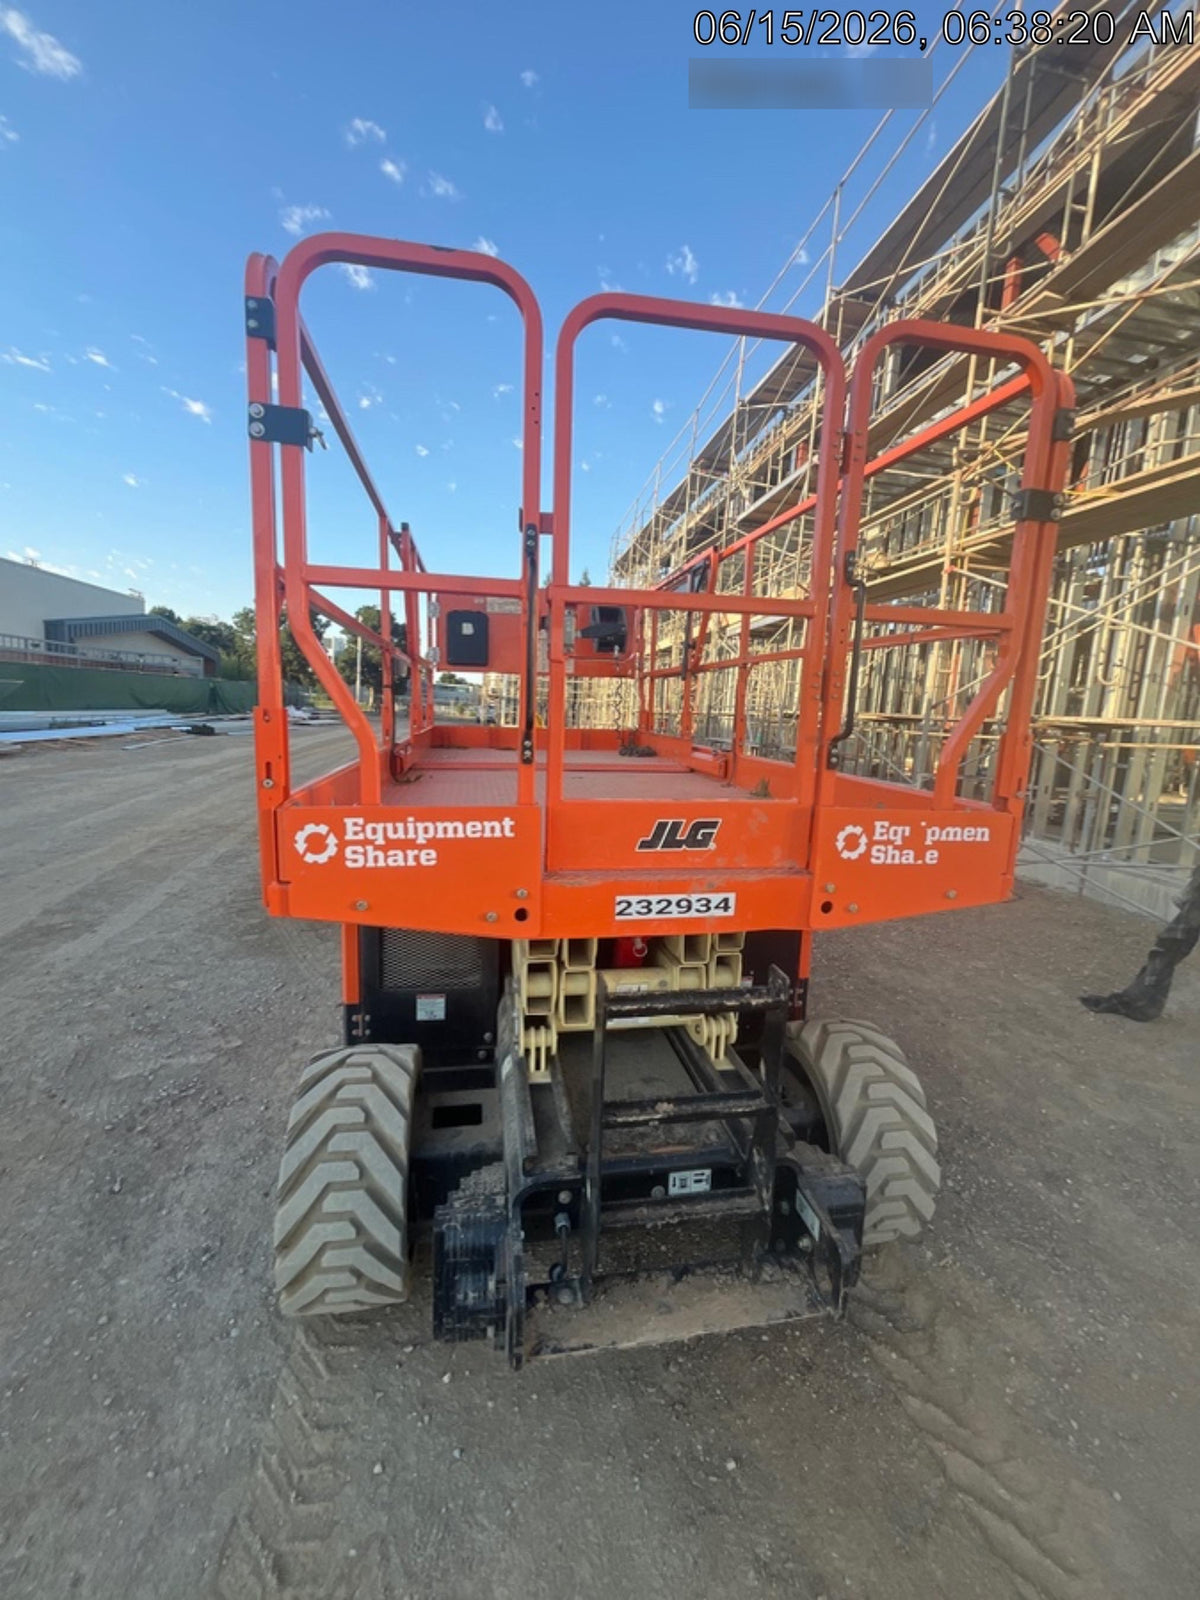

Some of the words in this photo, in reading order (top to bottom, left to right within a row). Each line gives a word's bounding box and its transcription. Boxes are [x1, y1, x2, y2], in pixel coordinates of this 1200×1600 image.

[343, 817, 515, 844] Equipment
[635, 818, 722, 851] JLG
[344, 846, 437, 868] Share
[615, 897, 731, 917] 232934
